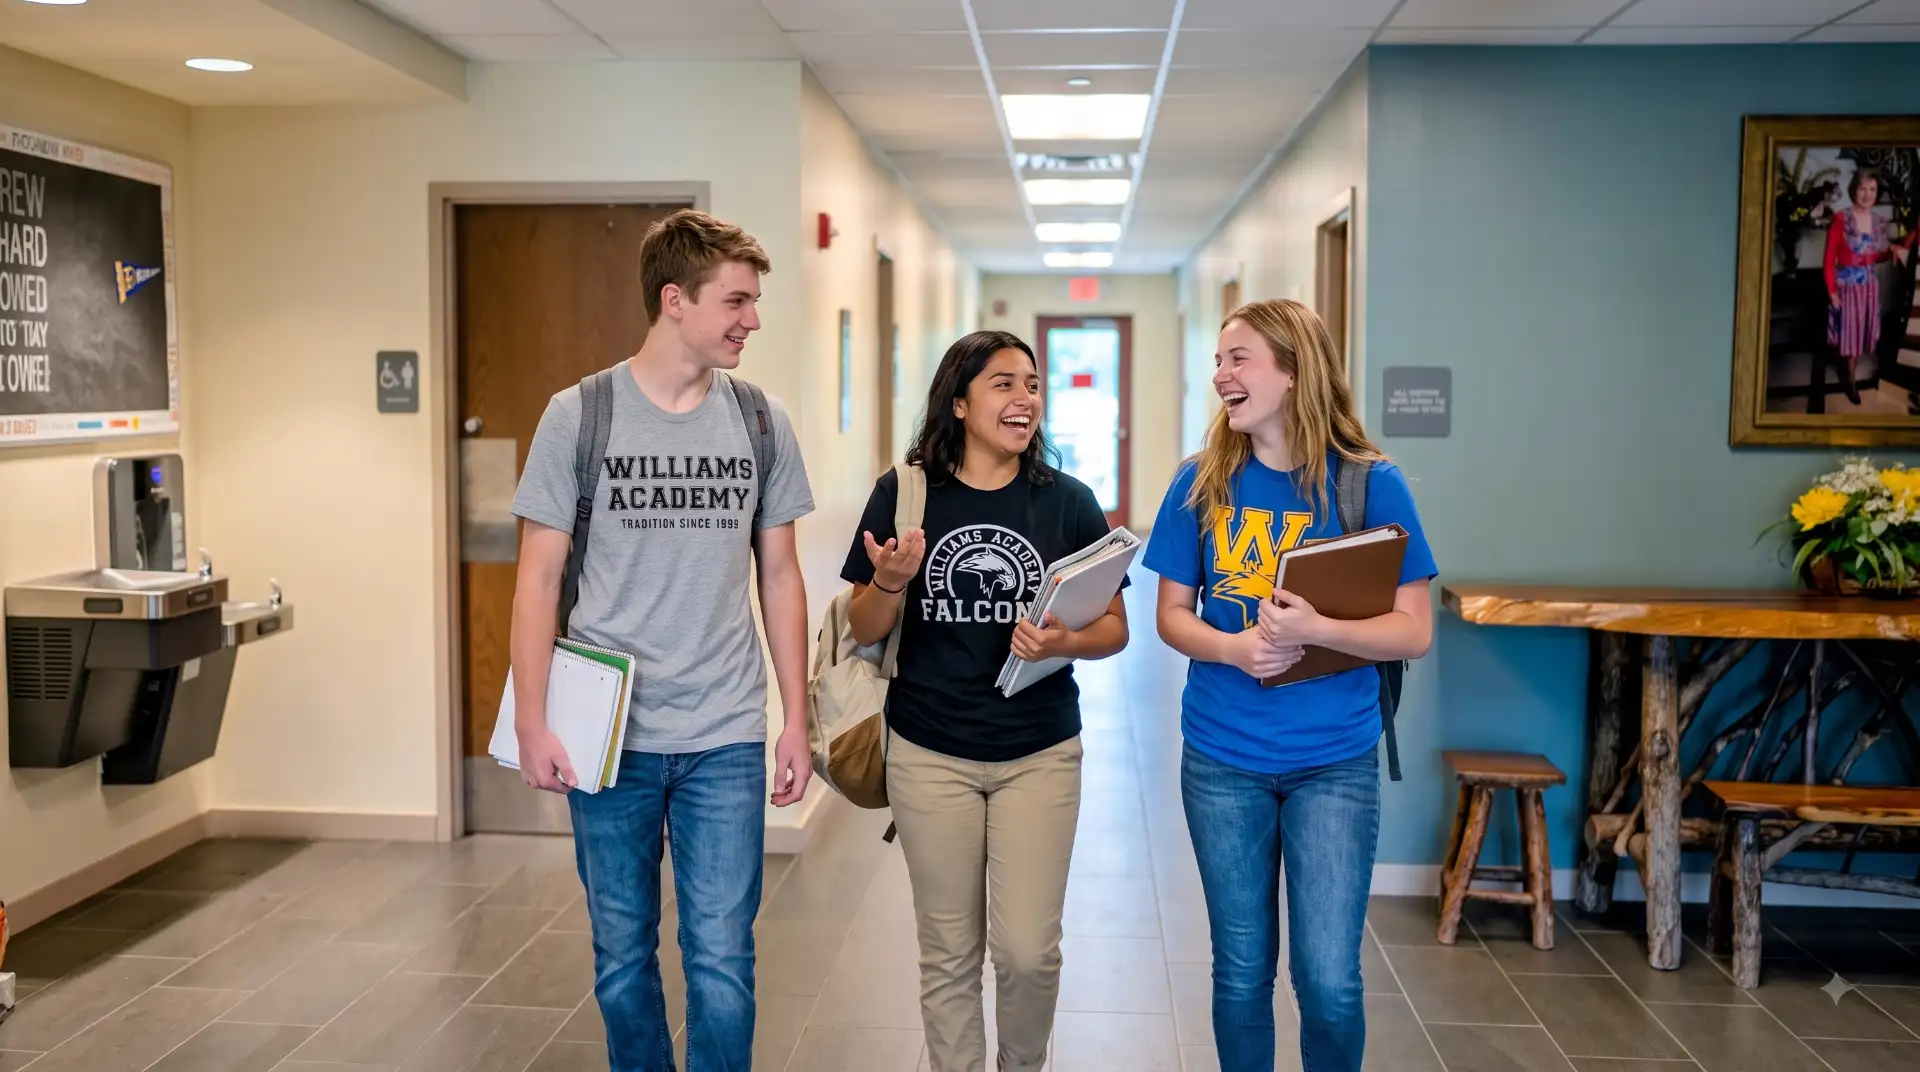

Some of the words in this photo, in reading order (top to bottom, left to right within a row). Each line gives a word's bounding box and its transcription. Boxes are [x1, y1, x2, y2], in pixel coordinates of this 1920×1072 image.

[0, 221, 48, 267] HARD
[0, 271, 48, 313] OWED
[603, 455, 754, 480] WILLIAMS
[608, 486, 750, 511] ACADEMY
[621, 518, 675, 529] TRADITION
[679, 518, 711, 529] SINCE
[716, 518, 739, 529] 1999
[930, 530, 983, 592] WILLIAMS
[991, 532, 1041, 594] ACADEMY
